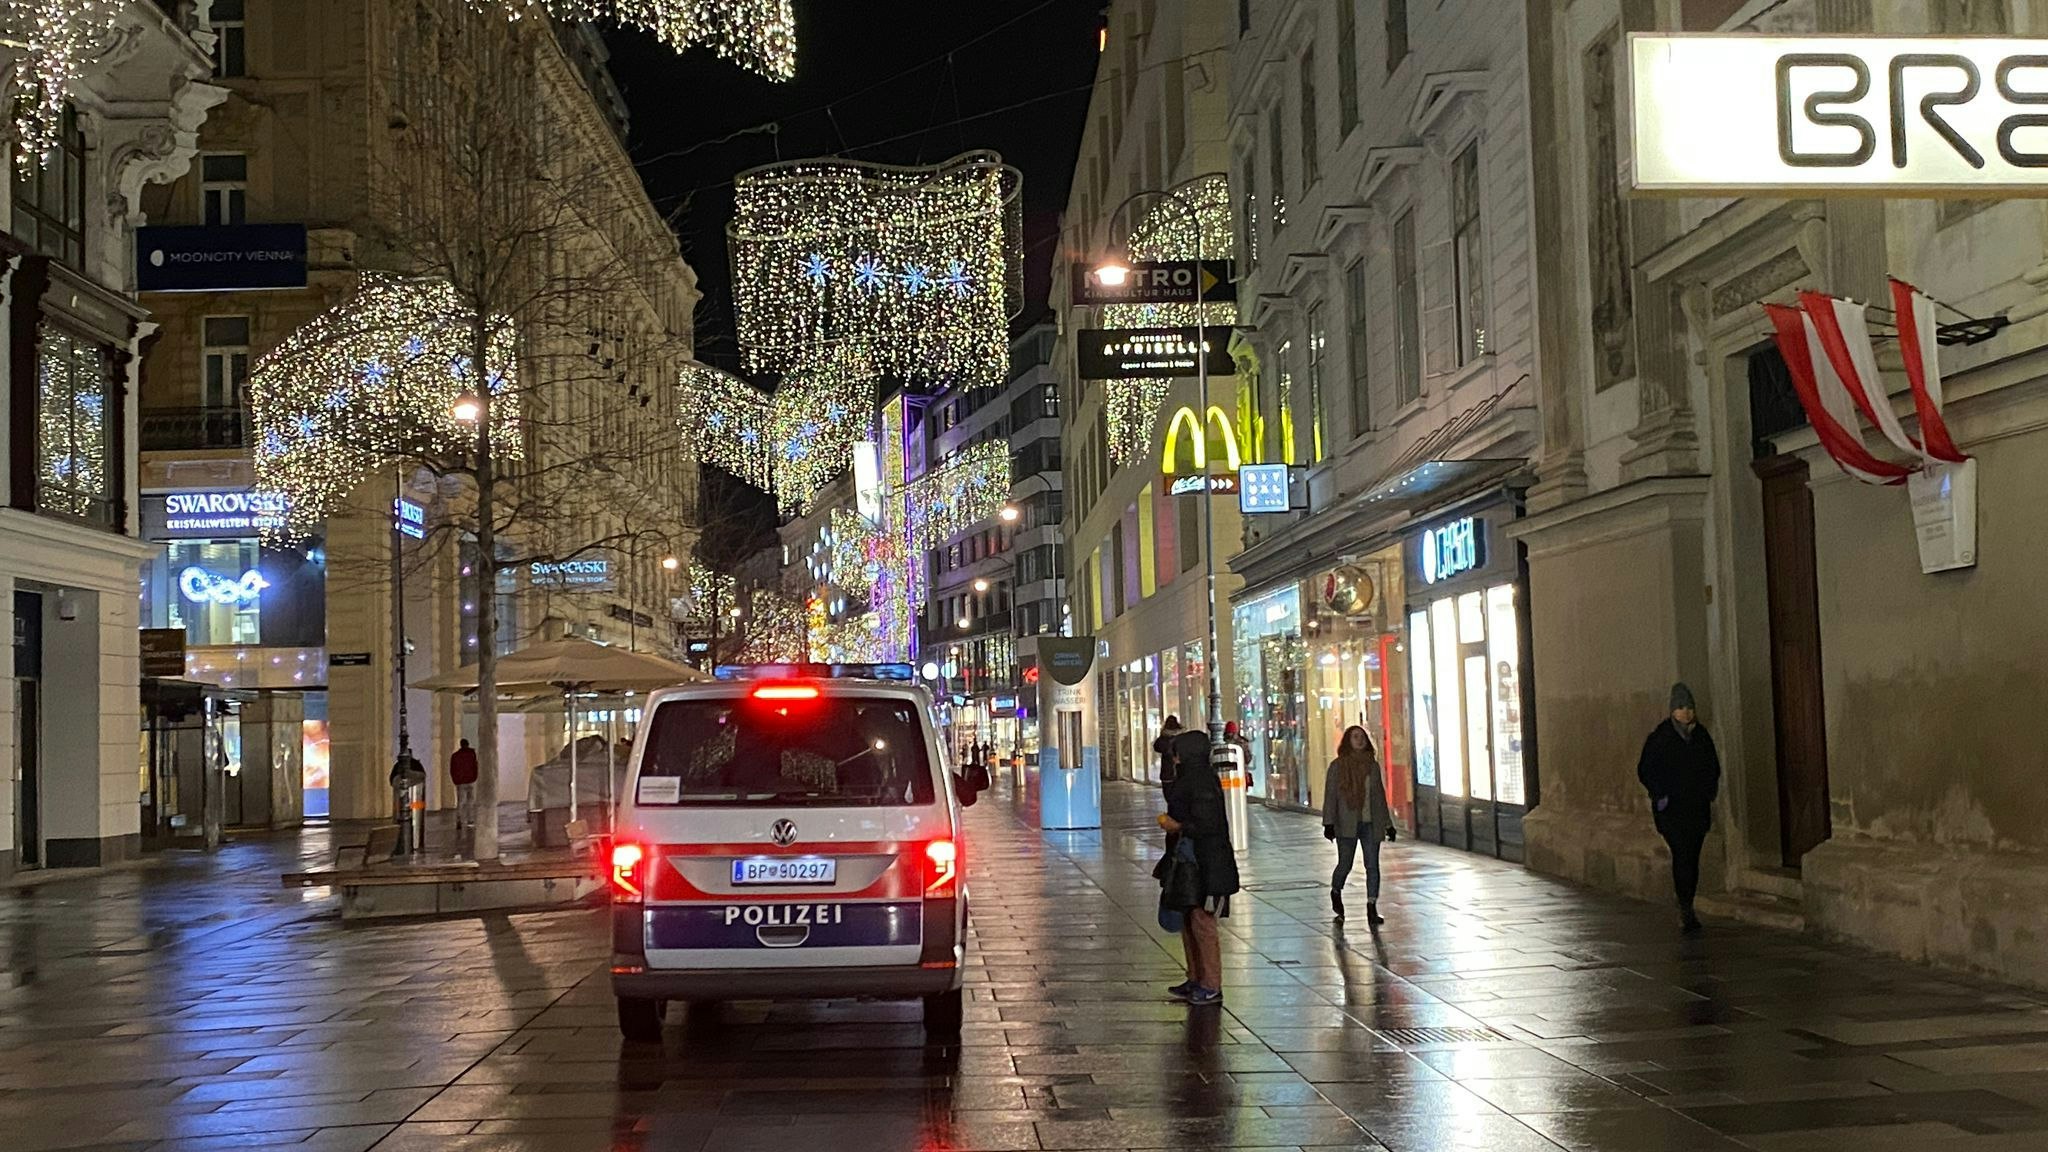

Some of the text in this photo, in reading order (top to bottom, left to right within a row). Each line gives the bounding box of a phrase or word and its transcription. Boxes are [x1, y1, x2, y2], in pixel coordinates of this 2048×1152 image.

[170, 250, 294, 263] MOONCITY VIENNA
[1163, 286, 1193, 297] HAUS
[165, 493, 286, 513] SWAROVSKI
[725, 904, 842, 926] POLIZEI
